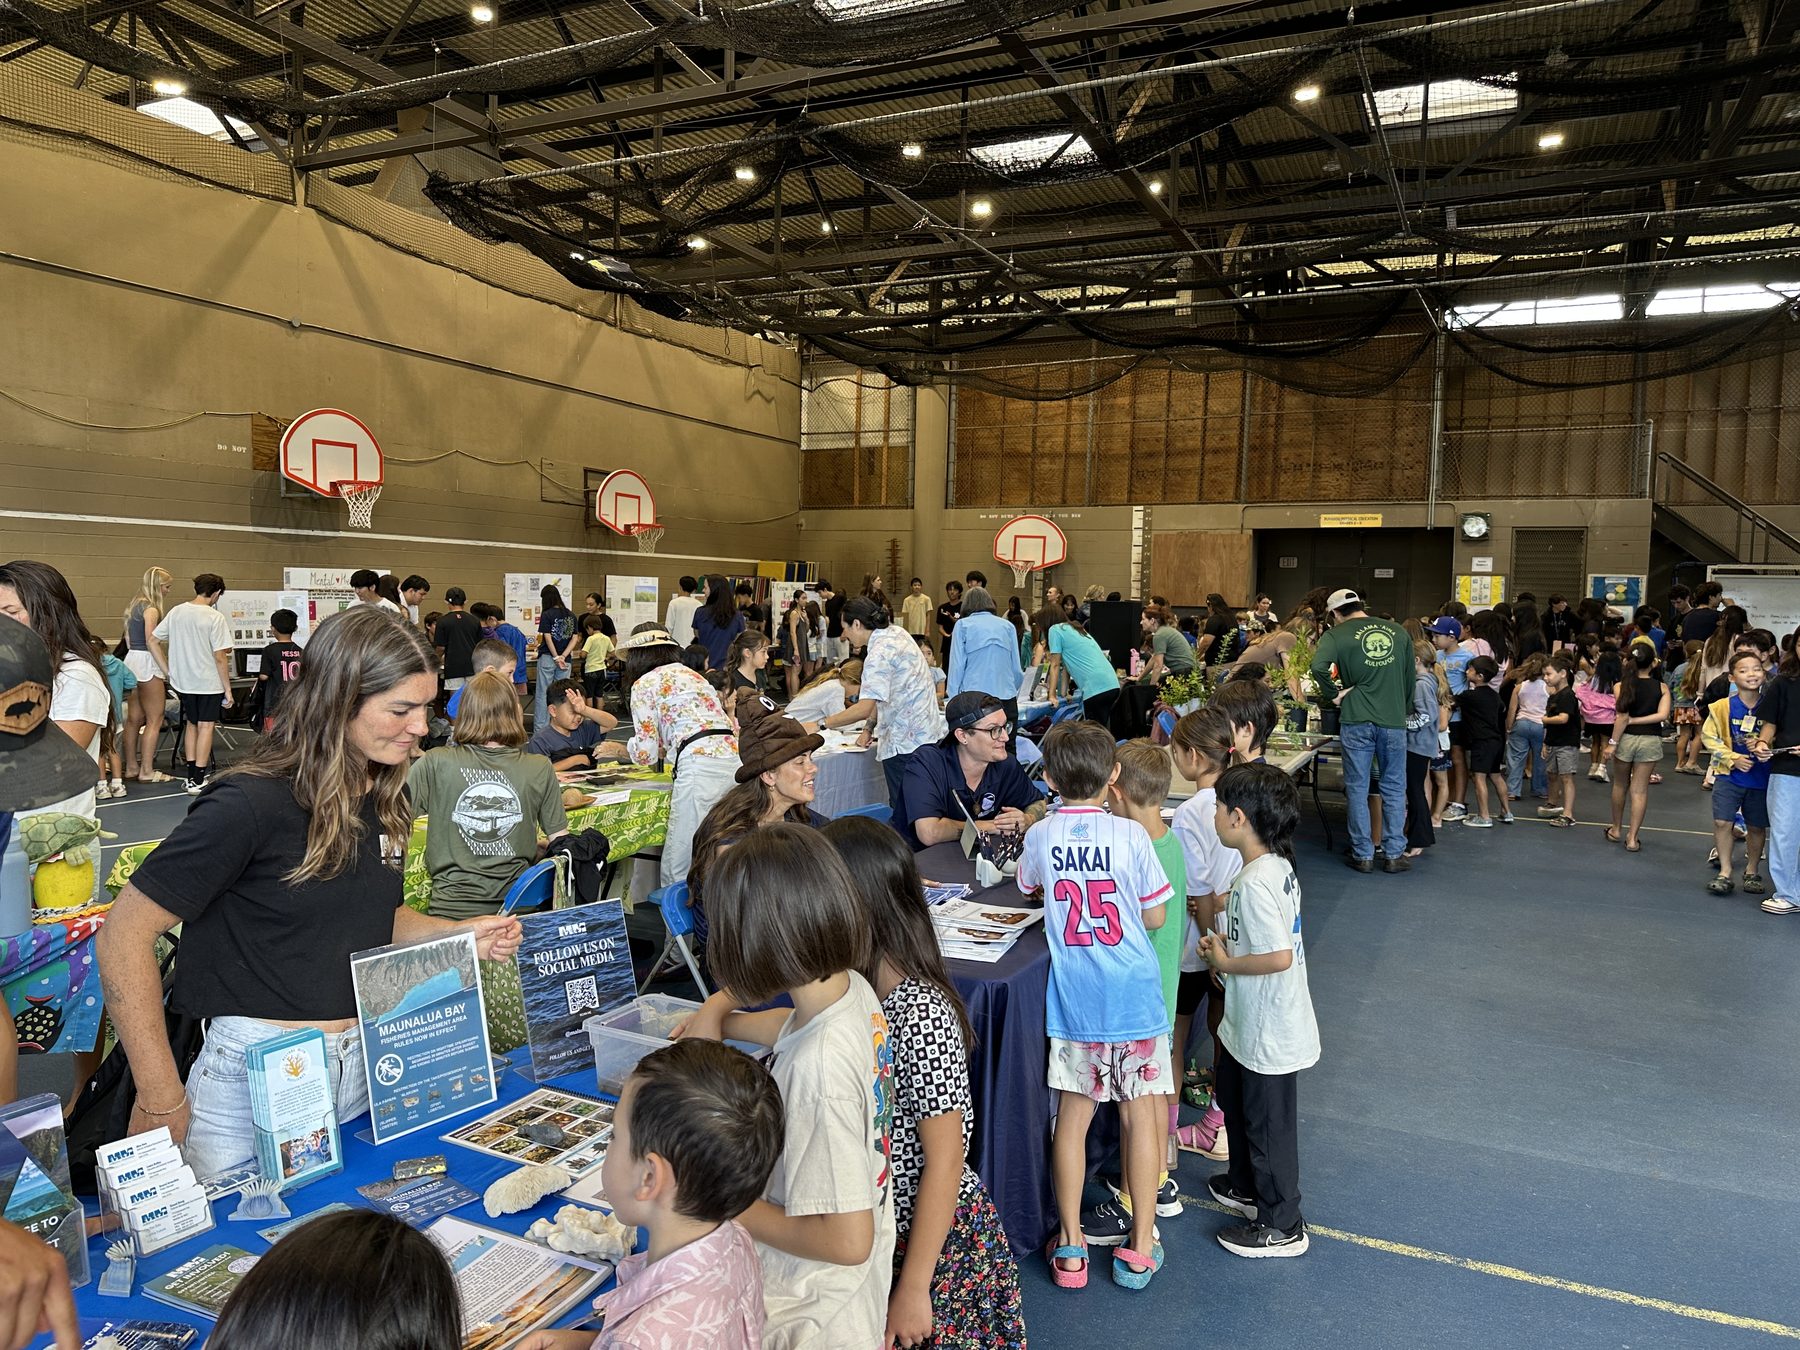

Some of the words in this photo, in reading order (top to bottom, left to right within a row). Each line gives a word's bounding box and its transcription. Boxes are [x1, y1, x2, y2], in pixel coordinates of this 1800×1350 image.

[280, 661, 300, 682] 10
[1051, 846, 1110, 872] SAKAI
[1054, 879, 1123, 946] 25
[533, 944, 581, 965] FOLLOW
[584, 942, 598, 954] US
[599, 937, 615, 949] ON
[538, 958, 579, 978] SOCIAL
[580, 950, 615, 968] MEDIA
[379, 1010, 442, 1036] MAUNALUA
[445, 1003, 465, 1018] BAY
[381, 1031, 411, 1045] FISHERIES
[412, 1019, 451, 1035] MANAGEMENT
[452, 1015, 467, 1024] AREA
[394, 1038, 413, 1048] RULES
[414, 1034, 428, 1042] NOW
[436, 1025, 456, 1036] EFFECT
[549, 1052, 566, 1060] FOLLOW
[41, 1216, 59, 1228] TO
[165, 1279, 184, 1290] GET
[183, 1251, 230, 1279] INVOLVED!
